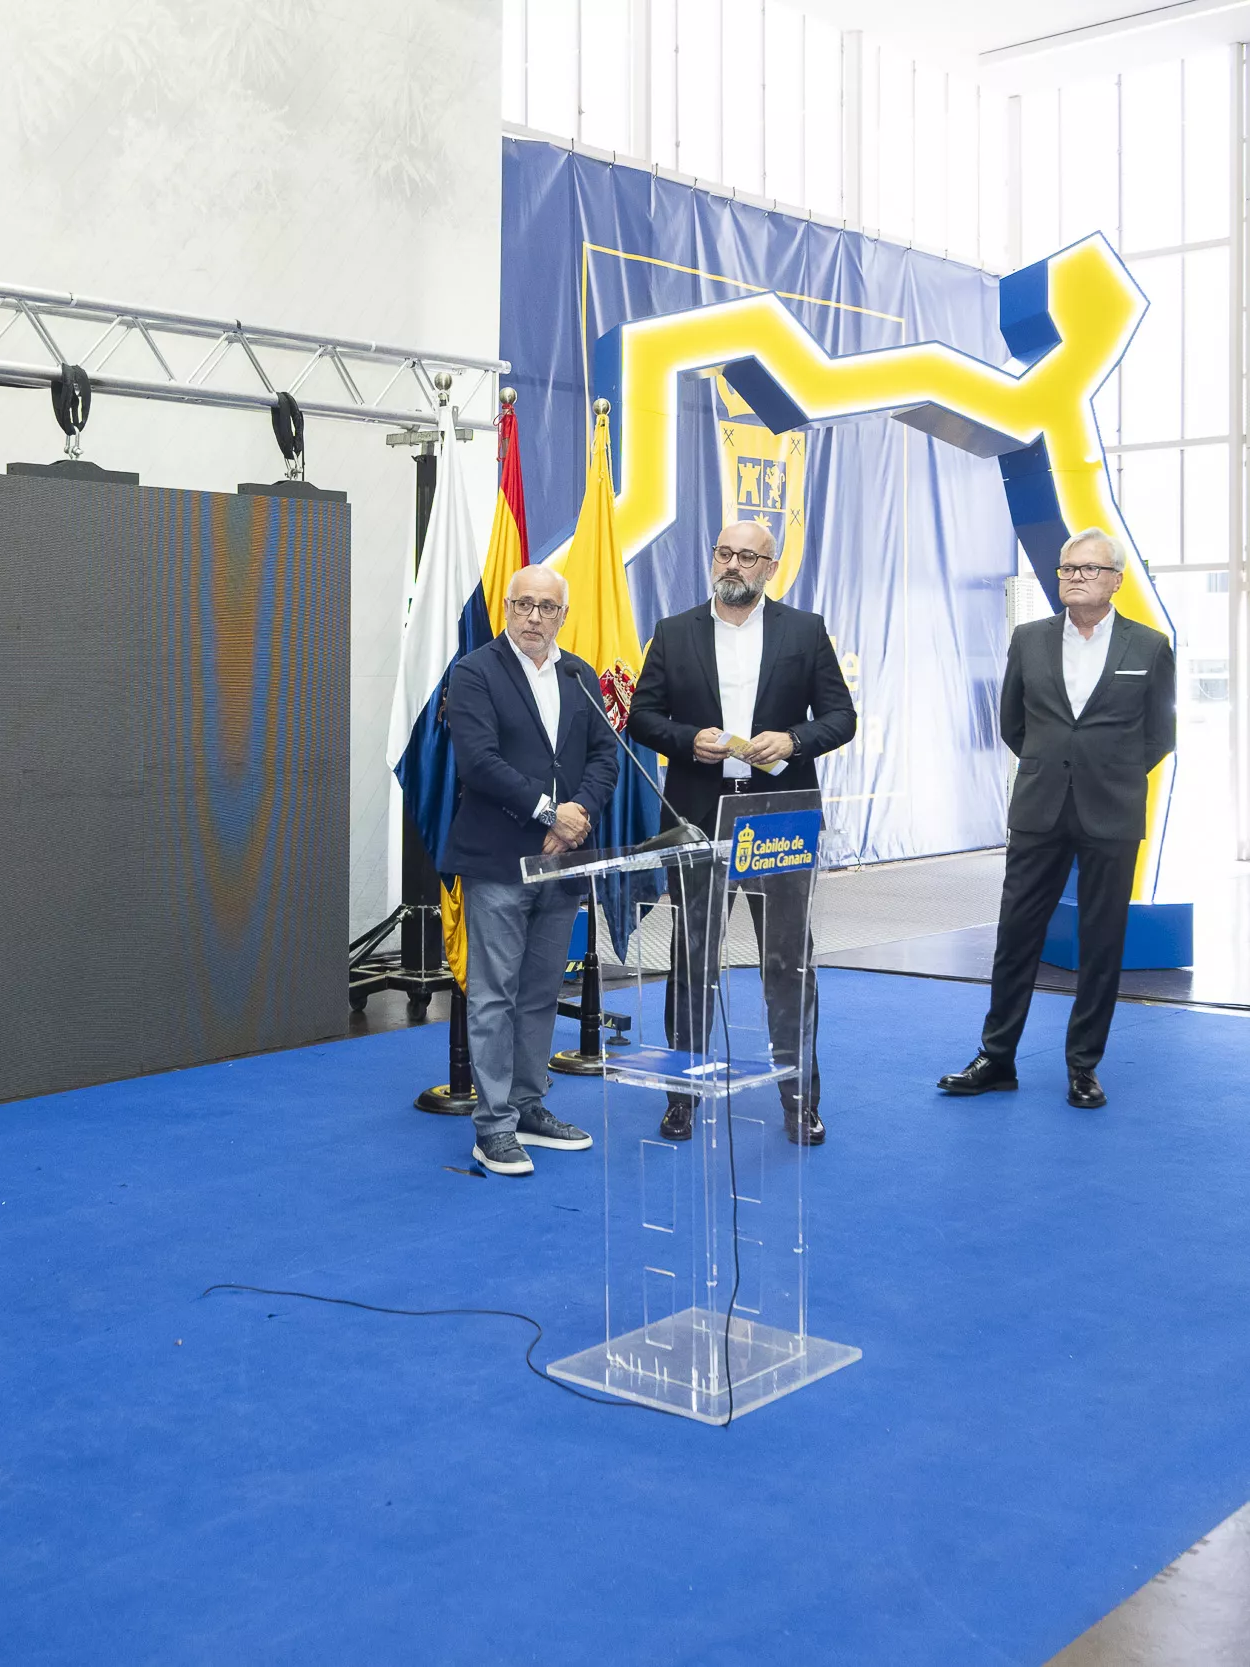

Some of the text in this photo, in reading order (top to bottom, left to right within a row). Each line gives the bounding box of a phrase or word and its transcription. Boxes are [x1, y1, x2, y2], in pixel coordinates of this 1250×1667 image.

[753, 835, 804, 854] Cabildo de
[751, 850, 812, 870] Gran Canaria
